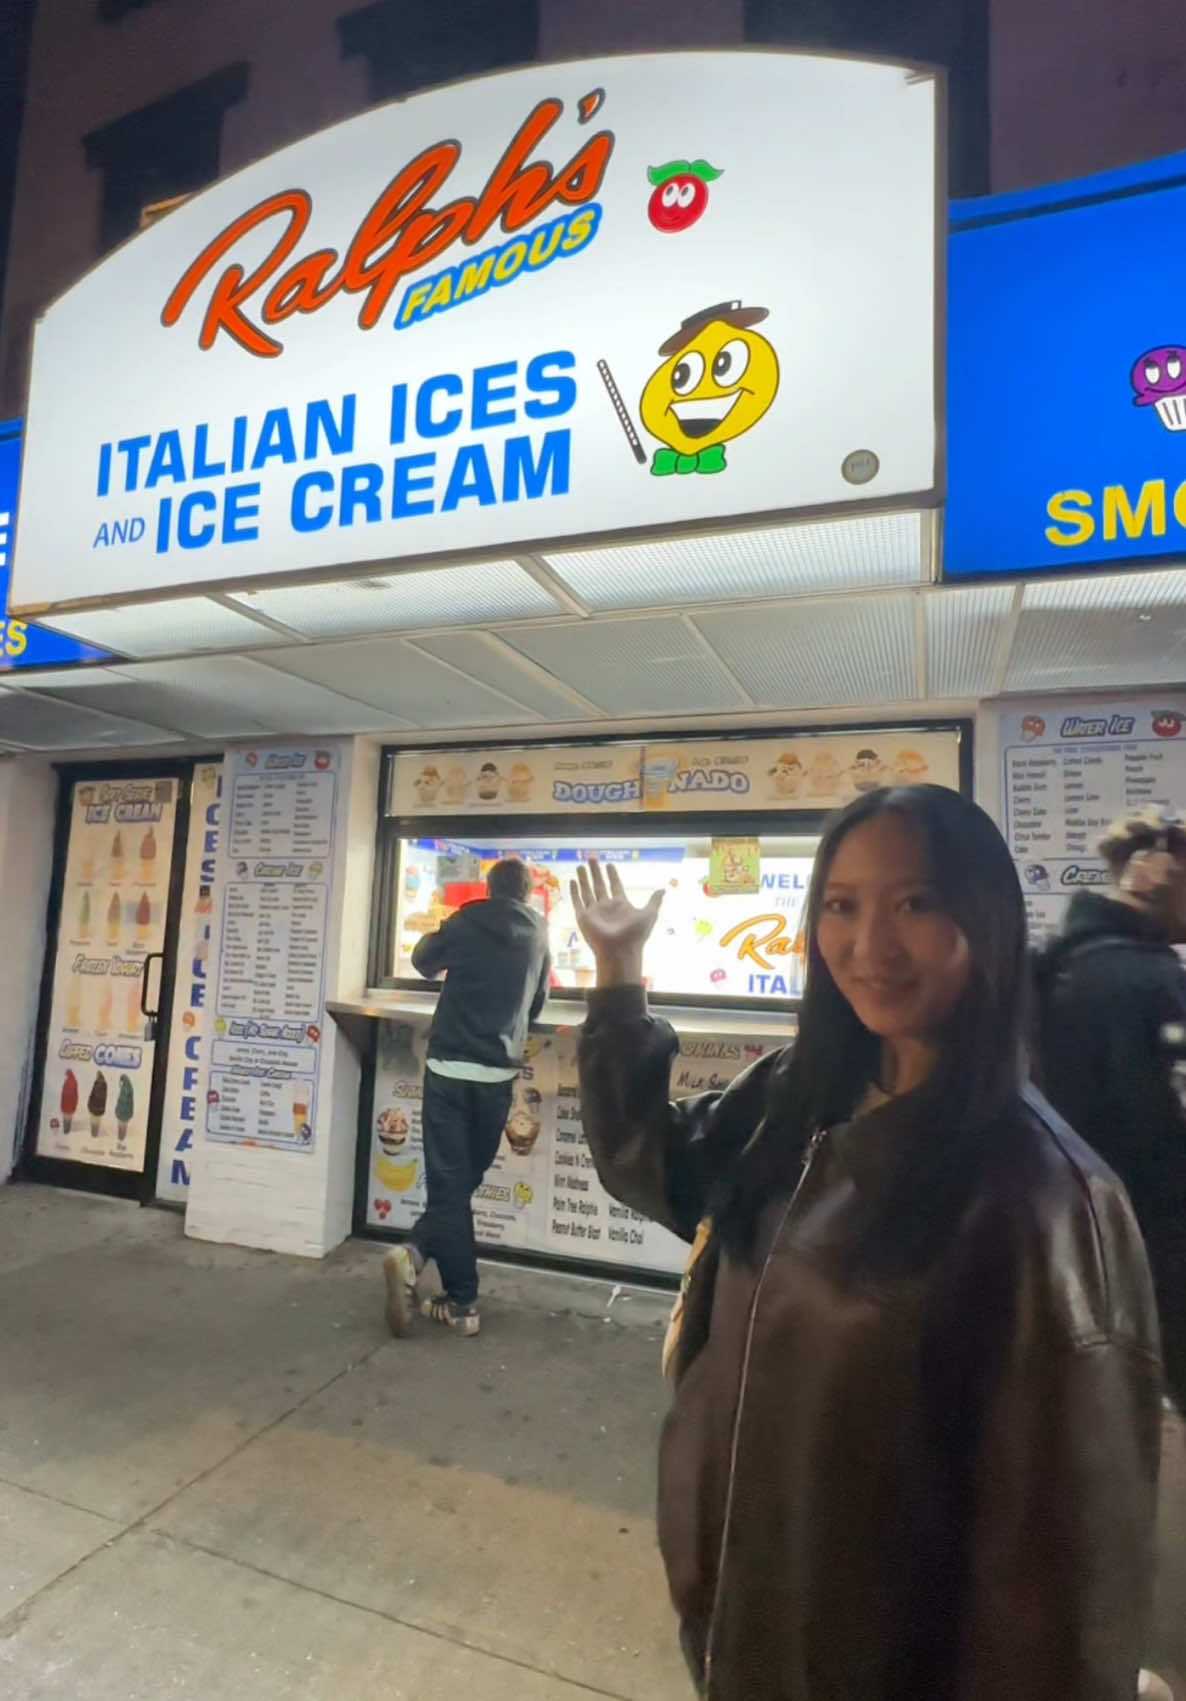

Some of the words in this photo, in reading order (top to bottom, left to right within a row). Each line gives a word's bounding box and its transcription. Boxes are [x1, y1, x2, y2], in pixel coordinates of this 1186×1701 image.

[161, 88, 615, 358] Ralph's
[399, 208, 596, 326] FAMOUS
[97, 395, 356, 498] ITALIAN
[389, 350, 578, 445] ICES
[93, 519, 146, 549] AND
[156, 484, 262, 555] ICE
[290, 428, 572, 535] CREAM
[1045, 482, 1186, 547] SM
[552, 780, 641, 804] DOUGH
[668, 769, 750, 793] NADO
